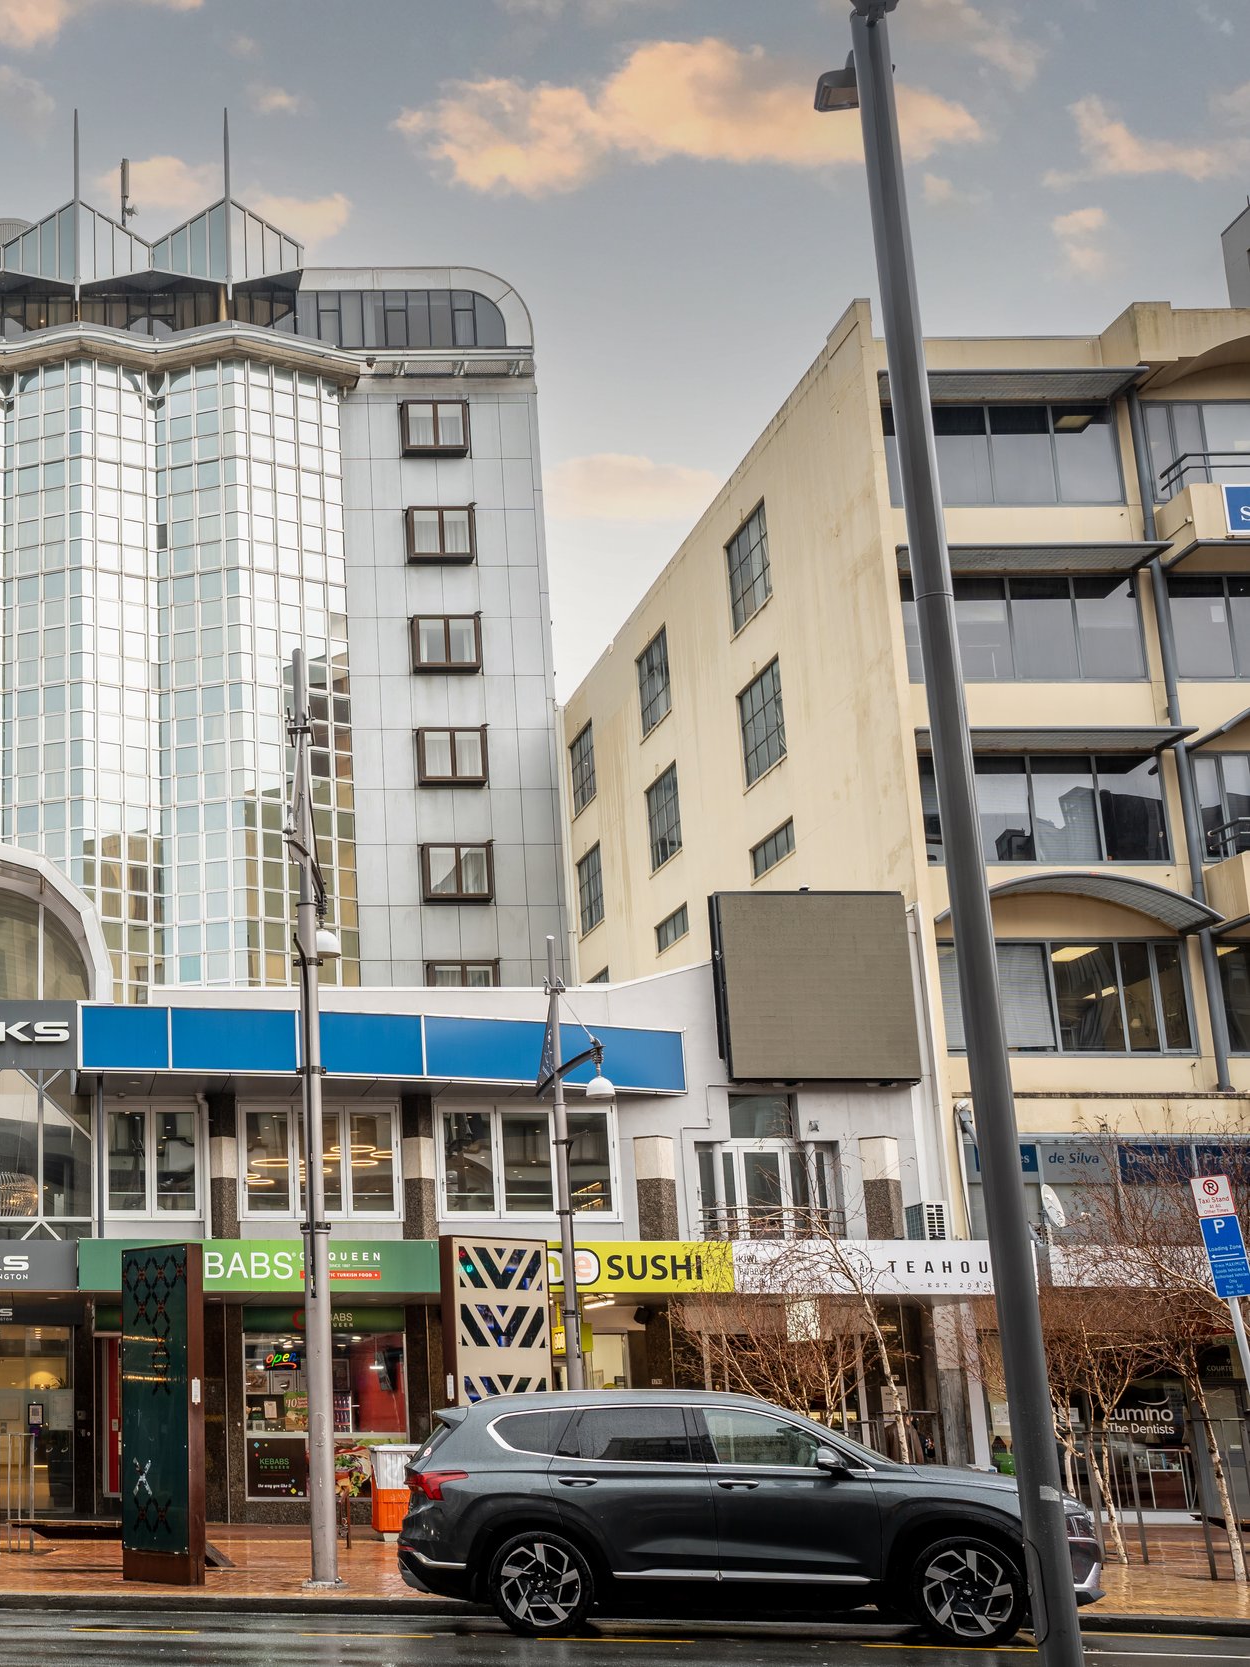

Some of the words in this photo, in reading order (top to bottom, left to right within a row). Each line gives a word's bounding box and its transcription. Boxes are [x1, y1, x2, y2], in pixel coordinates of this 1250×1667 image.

[1048, 1152, 1065, 1164] de
[1069, 1152, 1100, 1164] Silva
[1211, 1195, 1230, 1203] Stand
[1213, 1219, 1225, 1234] P
[328, 1252, 381, 1261] QUEEN
[204, 1251, 293, 1280] BABS
[606, 1254, 702, 1280] SUSHI
[887, 1260, 989, 1274] TEAHOU
[332, 1312, 353, 1322] ABS
[265, 1352, 298, 1367] open
[1108, 1422, 1129, 1432] The
[1130, 1422, 1175, 1434] Dentists
